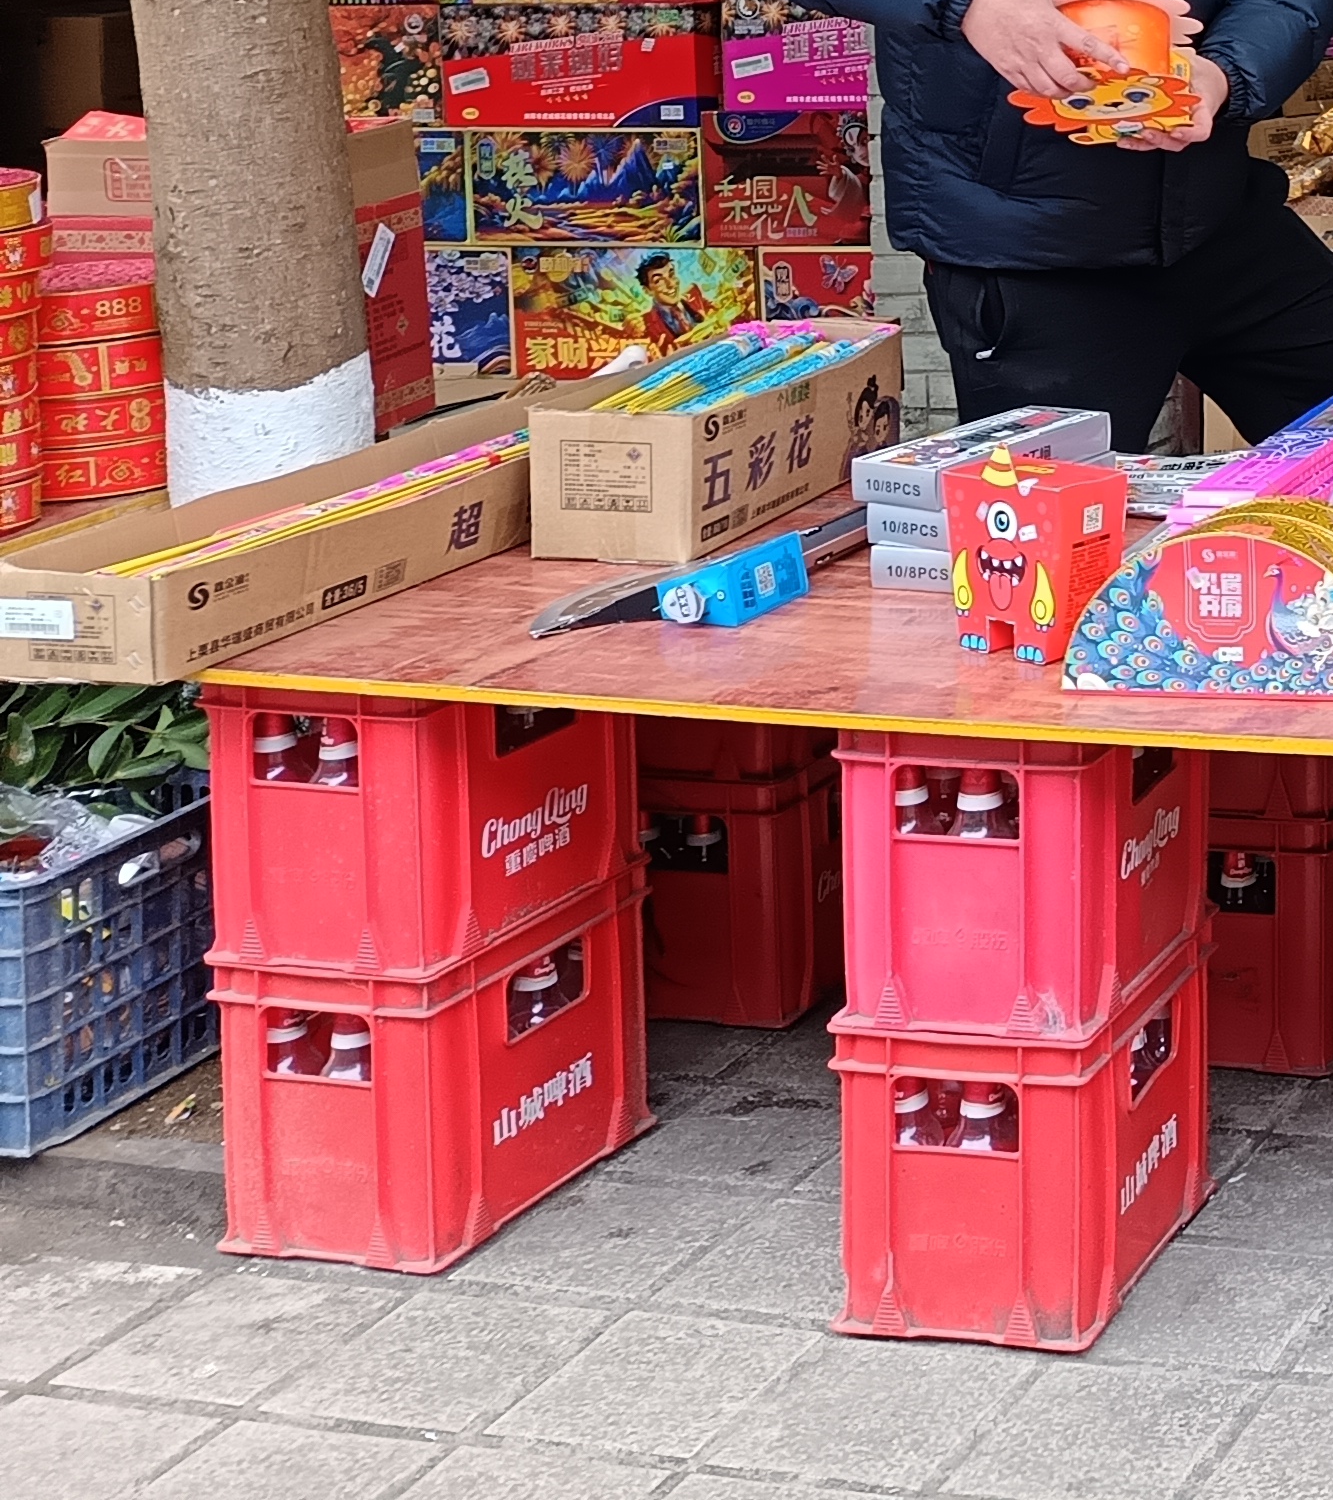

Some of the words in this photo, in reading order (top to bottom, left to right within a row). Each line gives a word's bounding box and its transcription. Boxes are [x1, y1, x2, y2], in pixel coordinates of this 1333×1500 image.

[95, 296, 142, 318] 888
[702, 414, 814, 511] 五彩花
[865, 477, 921, 498] 10/8PCS
[445, 500, 484, 556] 超
[881, 518, 939, 539] 10/8PCS
[886, 562, 950, 582] 10/8PCS
[493, 1051, 594, 1148] 山城啤酒
